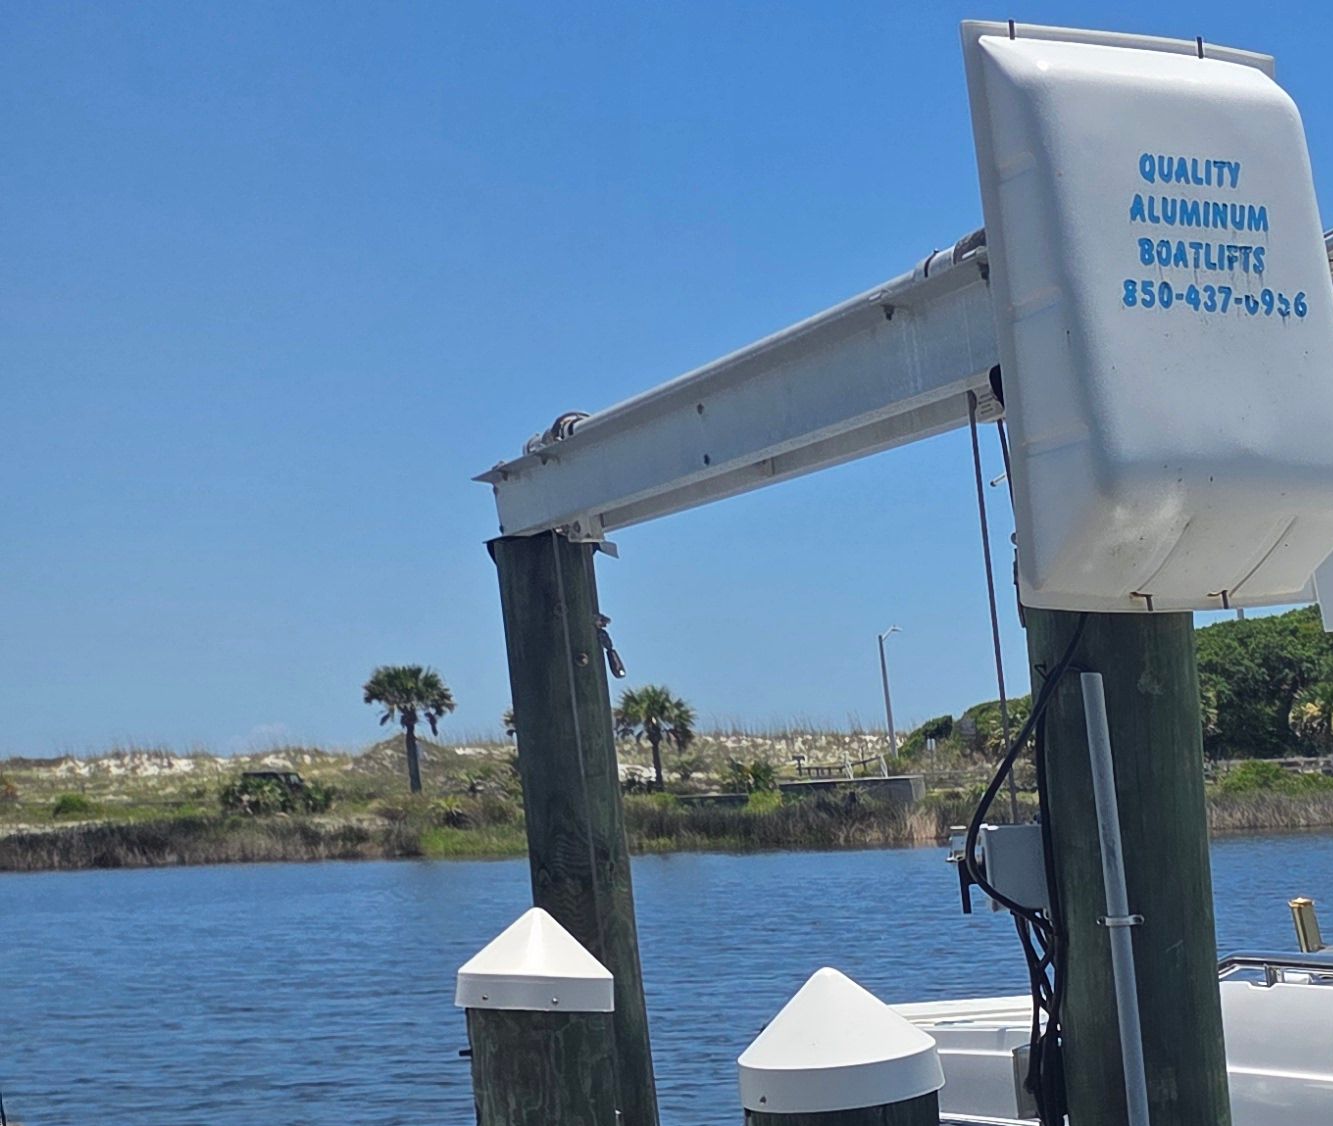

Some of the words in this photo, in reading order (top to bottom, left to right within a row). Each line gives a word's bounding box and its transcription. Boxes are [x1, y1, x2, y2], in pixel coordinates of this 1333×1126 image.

[1138, 153, 1241, 188] QUALITY
[1129, 193, 1269, 232] ALUMINUM
[1138, 238, 1265, 274] BOATLIFTS
